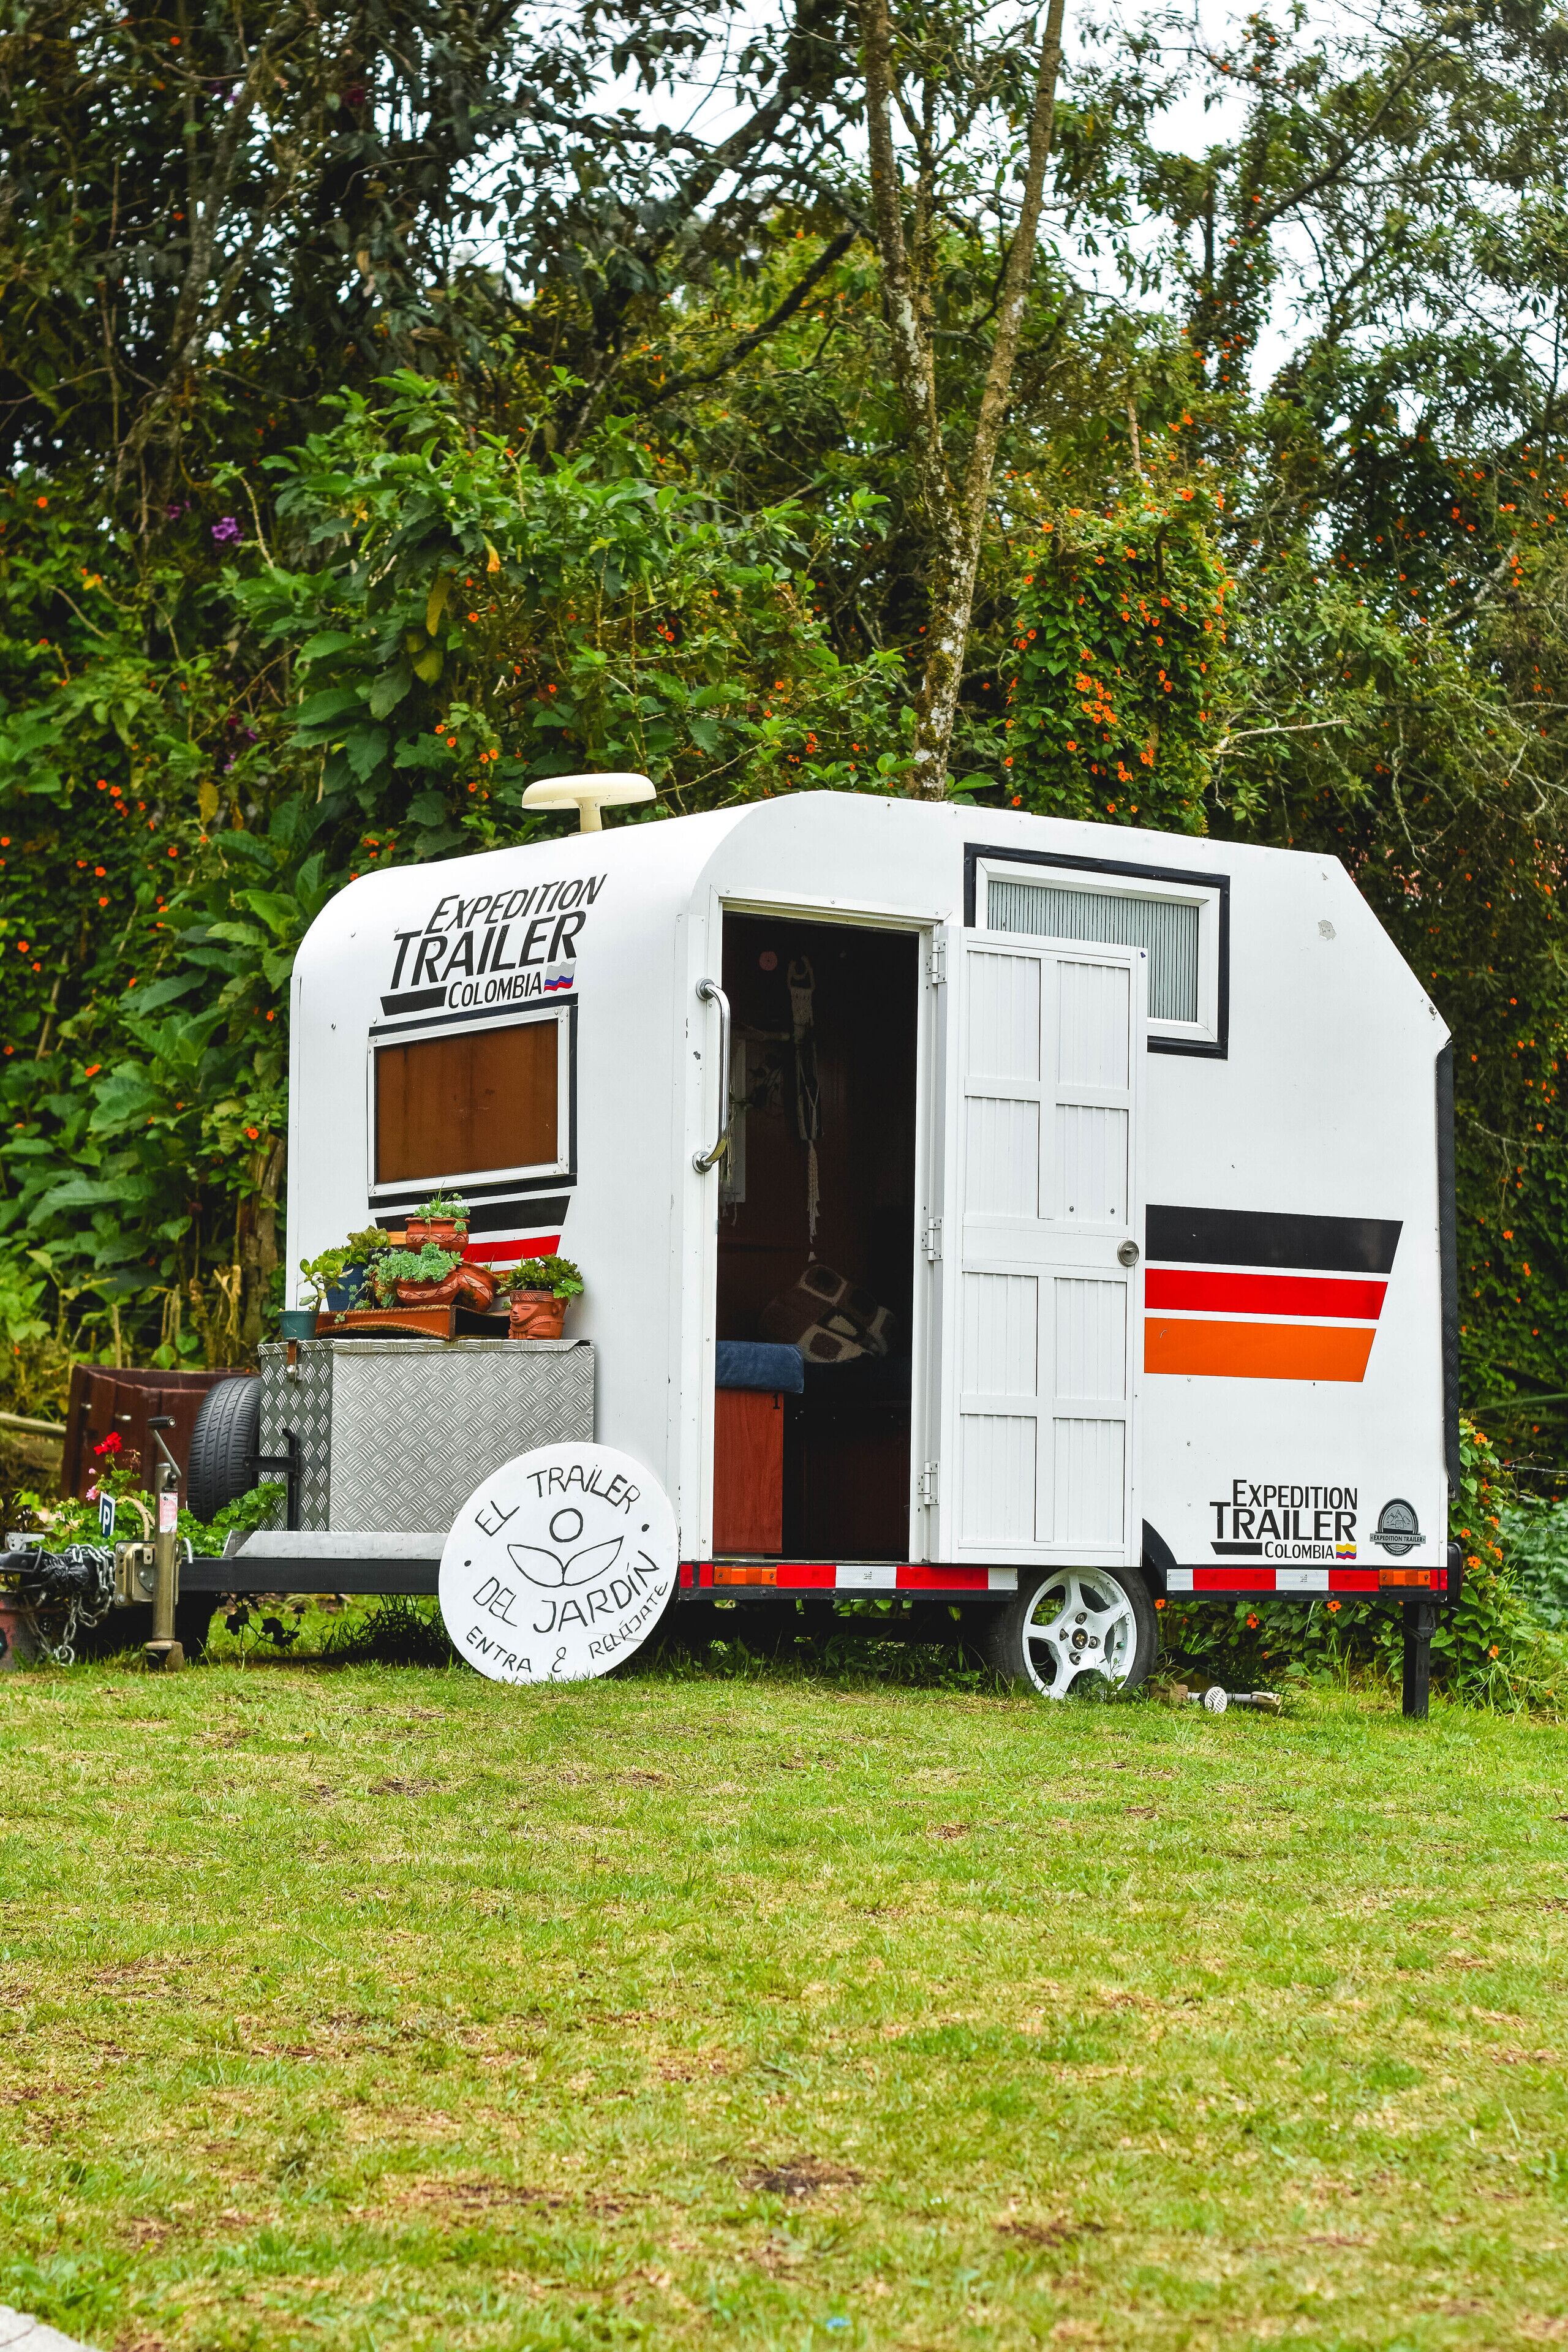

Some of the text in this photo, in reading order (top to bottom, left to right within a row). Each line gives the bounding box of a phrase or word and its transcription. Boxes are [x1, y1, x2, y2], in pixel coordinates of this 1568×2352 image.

[424, 874, 608, 935] EXPEDITION
[390, 911, 586, 990] TRAILER
[448, 971, 542, 1009] COLOMBIA
[475, 1464, 641, 1536] EL TRAILER
[1233, 1479, 1357, 1510] EXPEDITION
[102, 1505, 110, 1534] P
[1210, 1501, 1357, 1541] TRAILER
[1265, 1541, 1335, 1559] COLOMBIA
[473, 1577, 517, 1627] DEL
[466, 1626, 532, 1673] ENTRA
